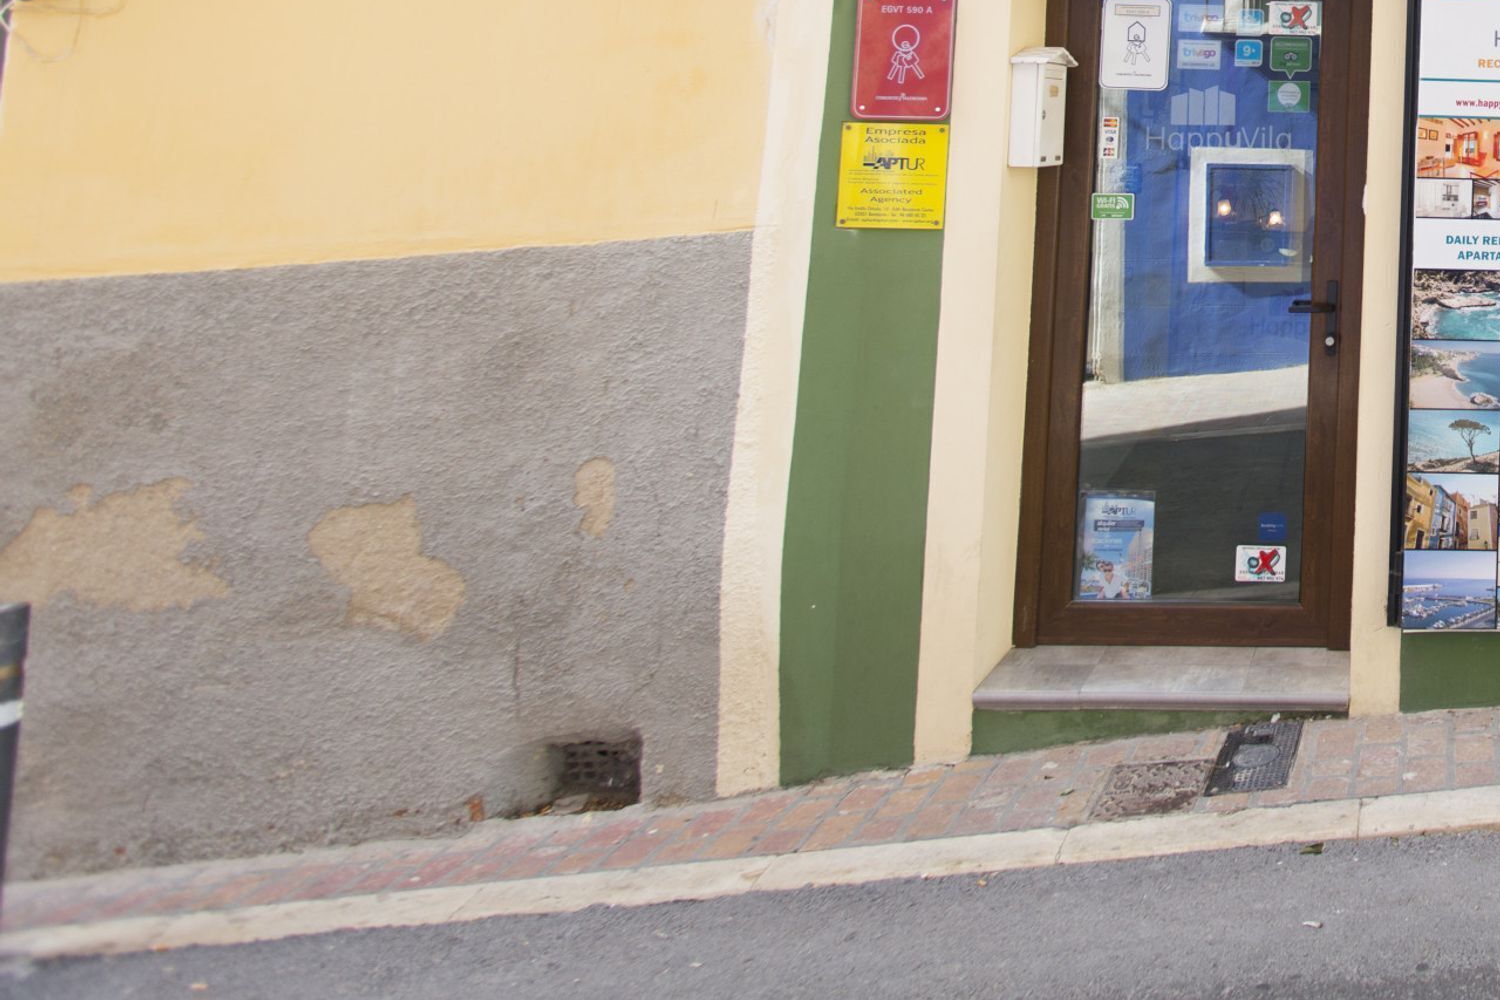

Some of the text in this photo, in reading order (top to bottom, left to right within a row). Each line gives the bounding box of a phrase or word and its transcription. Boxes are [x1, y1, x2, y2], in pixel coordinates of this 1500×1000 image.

[881, 5, 904, 14] EGVT
[926, 6, 933, 14] A
[866, 127, 926, 136] Empresa
[864, 136, 926, 144] Asociada
[873, 156, 925, 171] APTUR
[860, 187, 923, 195] Associated
[870, 196, 911, 204] Agency
[1445, 235, 1479, 246] DAILY
